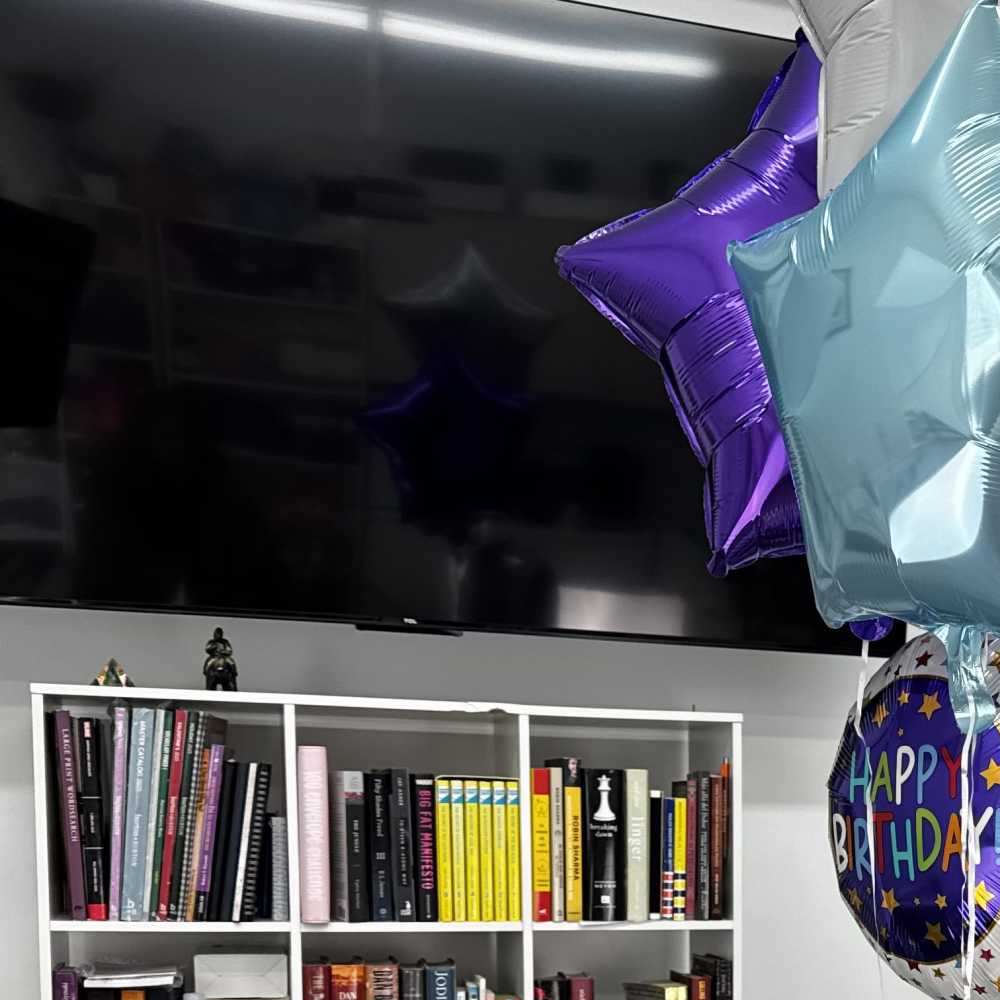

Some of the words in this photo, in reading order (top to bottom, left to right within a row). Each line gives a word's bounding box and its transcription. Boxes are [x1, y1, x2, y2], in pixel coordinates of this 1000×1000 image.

[62, 728, 72, 755] LARGE
[64, 757, 74, 783] PRINT
[850, 744, 963, 805] HAPPY
[418, 790, 431, 807] BIG
[66, 785, 77, 843] WORDSEARCH
[419, 811, 432, 829] FAT
[628, 816, 645, 862] linger
[420, 832, 434, 889] MANIFESTO
[373, 970, 393, 991] DAN
[434, 971, 448, 1000] JODI
[339, 992, 358, 1000] DAN
